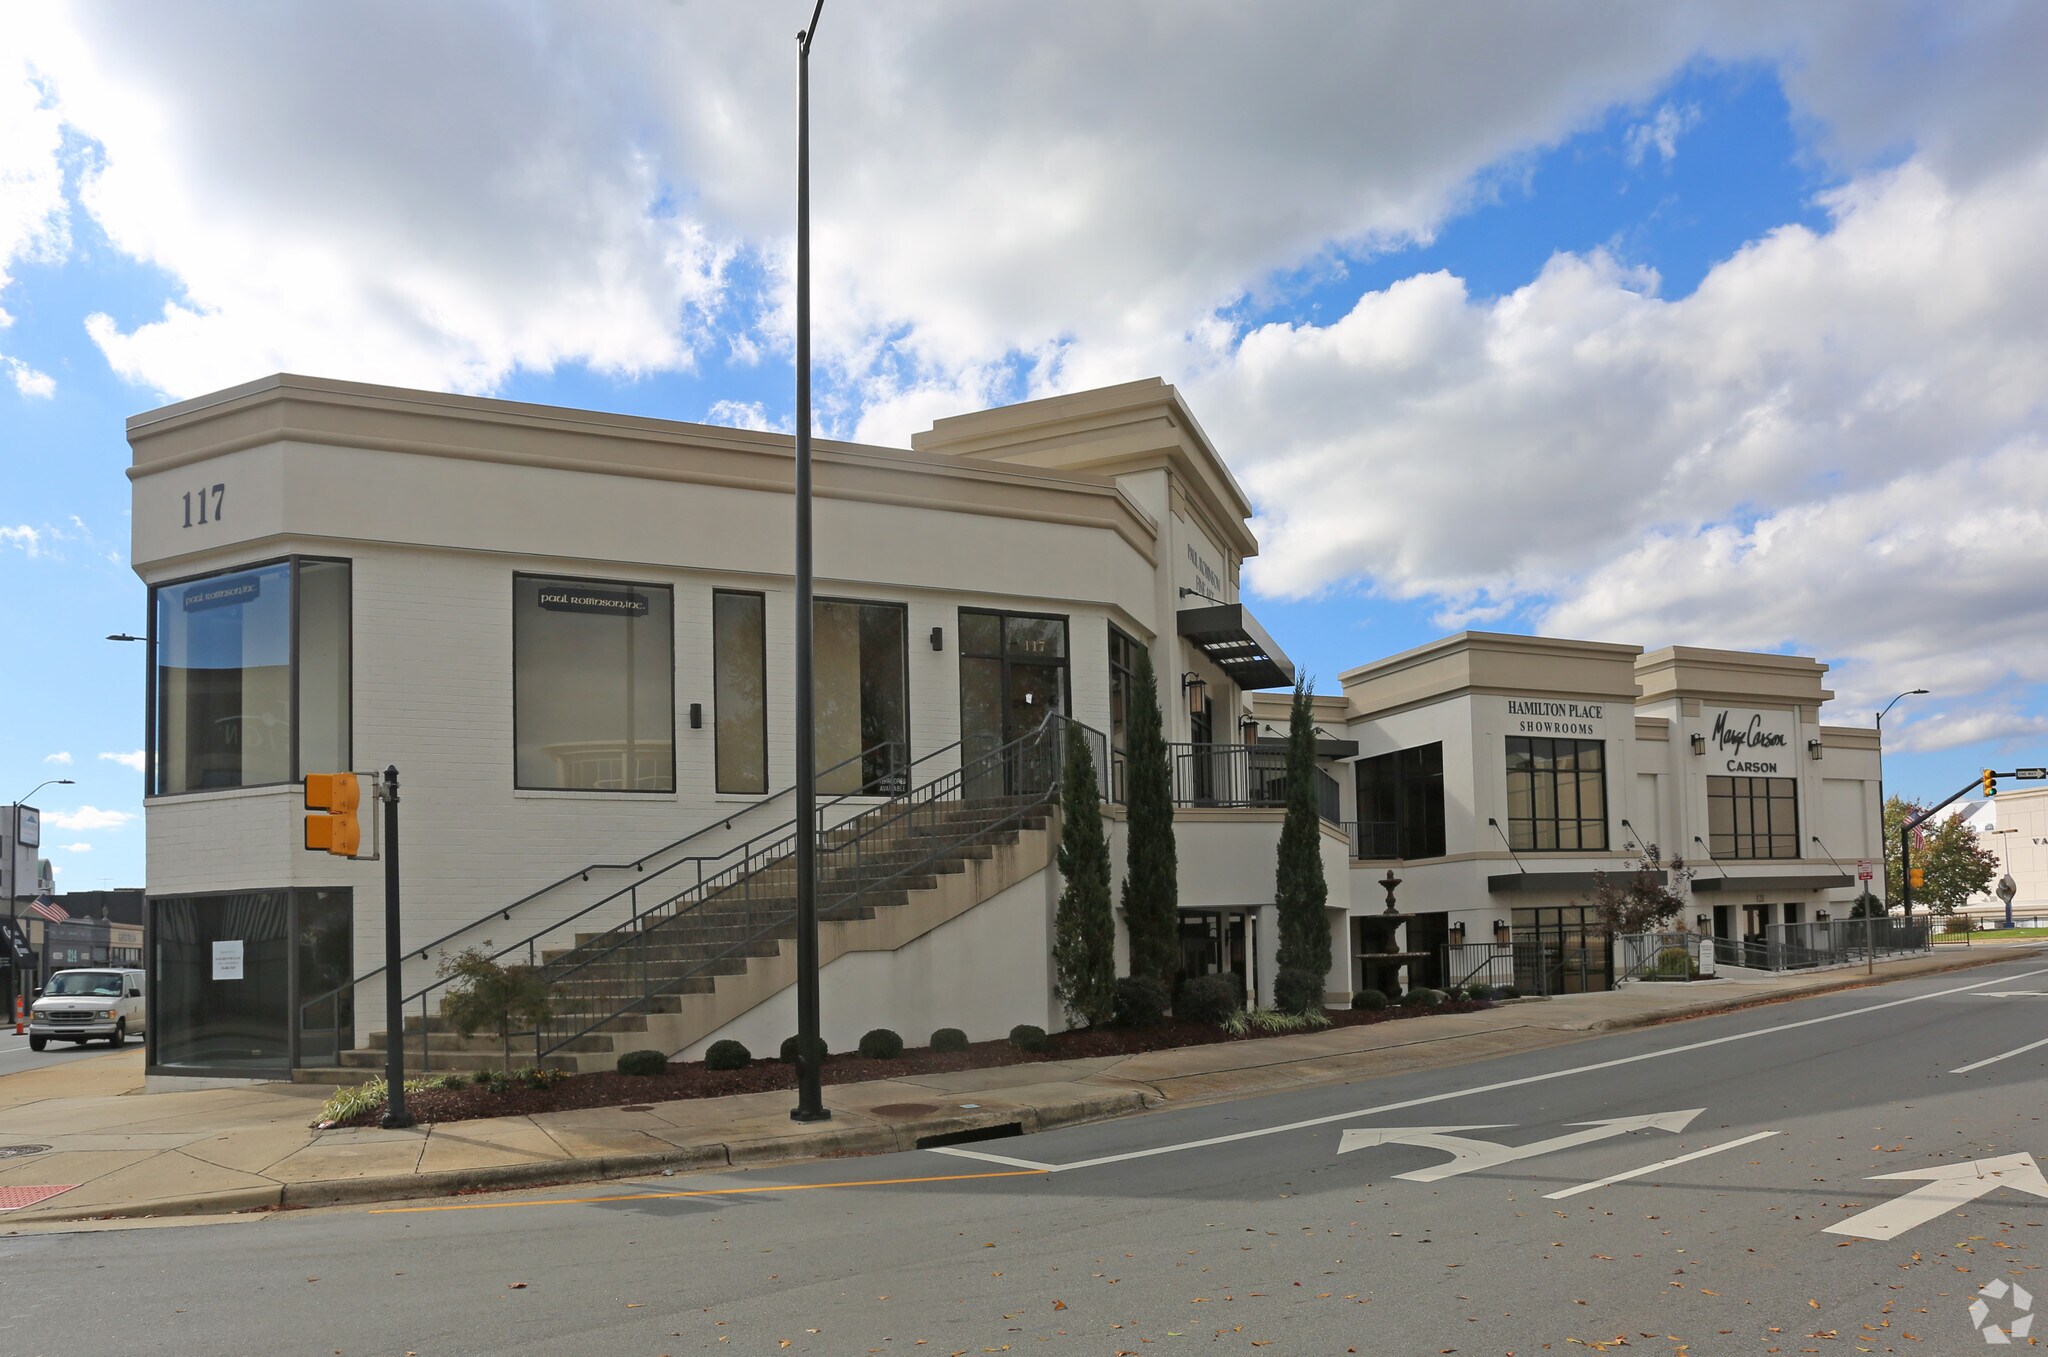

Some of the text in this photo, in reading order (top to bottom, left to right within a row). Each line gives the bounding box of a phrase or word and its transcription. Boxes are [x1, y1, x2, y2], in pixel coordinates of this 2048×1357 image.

[182, 483, 225, 528] 117
[1025, 640, 1045, 652] 117
[1508, 700, 1603, 719] HAMILTON PLACE
[1520, 720, 1594, 735] SHOWROOMS
[1712, 710, 1787, 756] Marge Carson
[1727, 759, 1777, 773] CARSON
